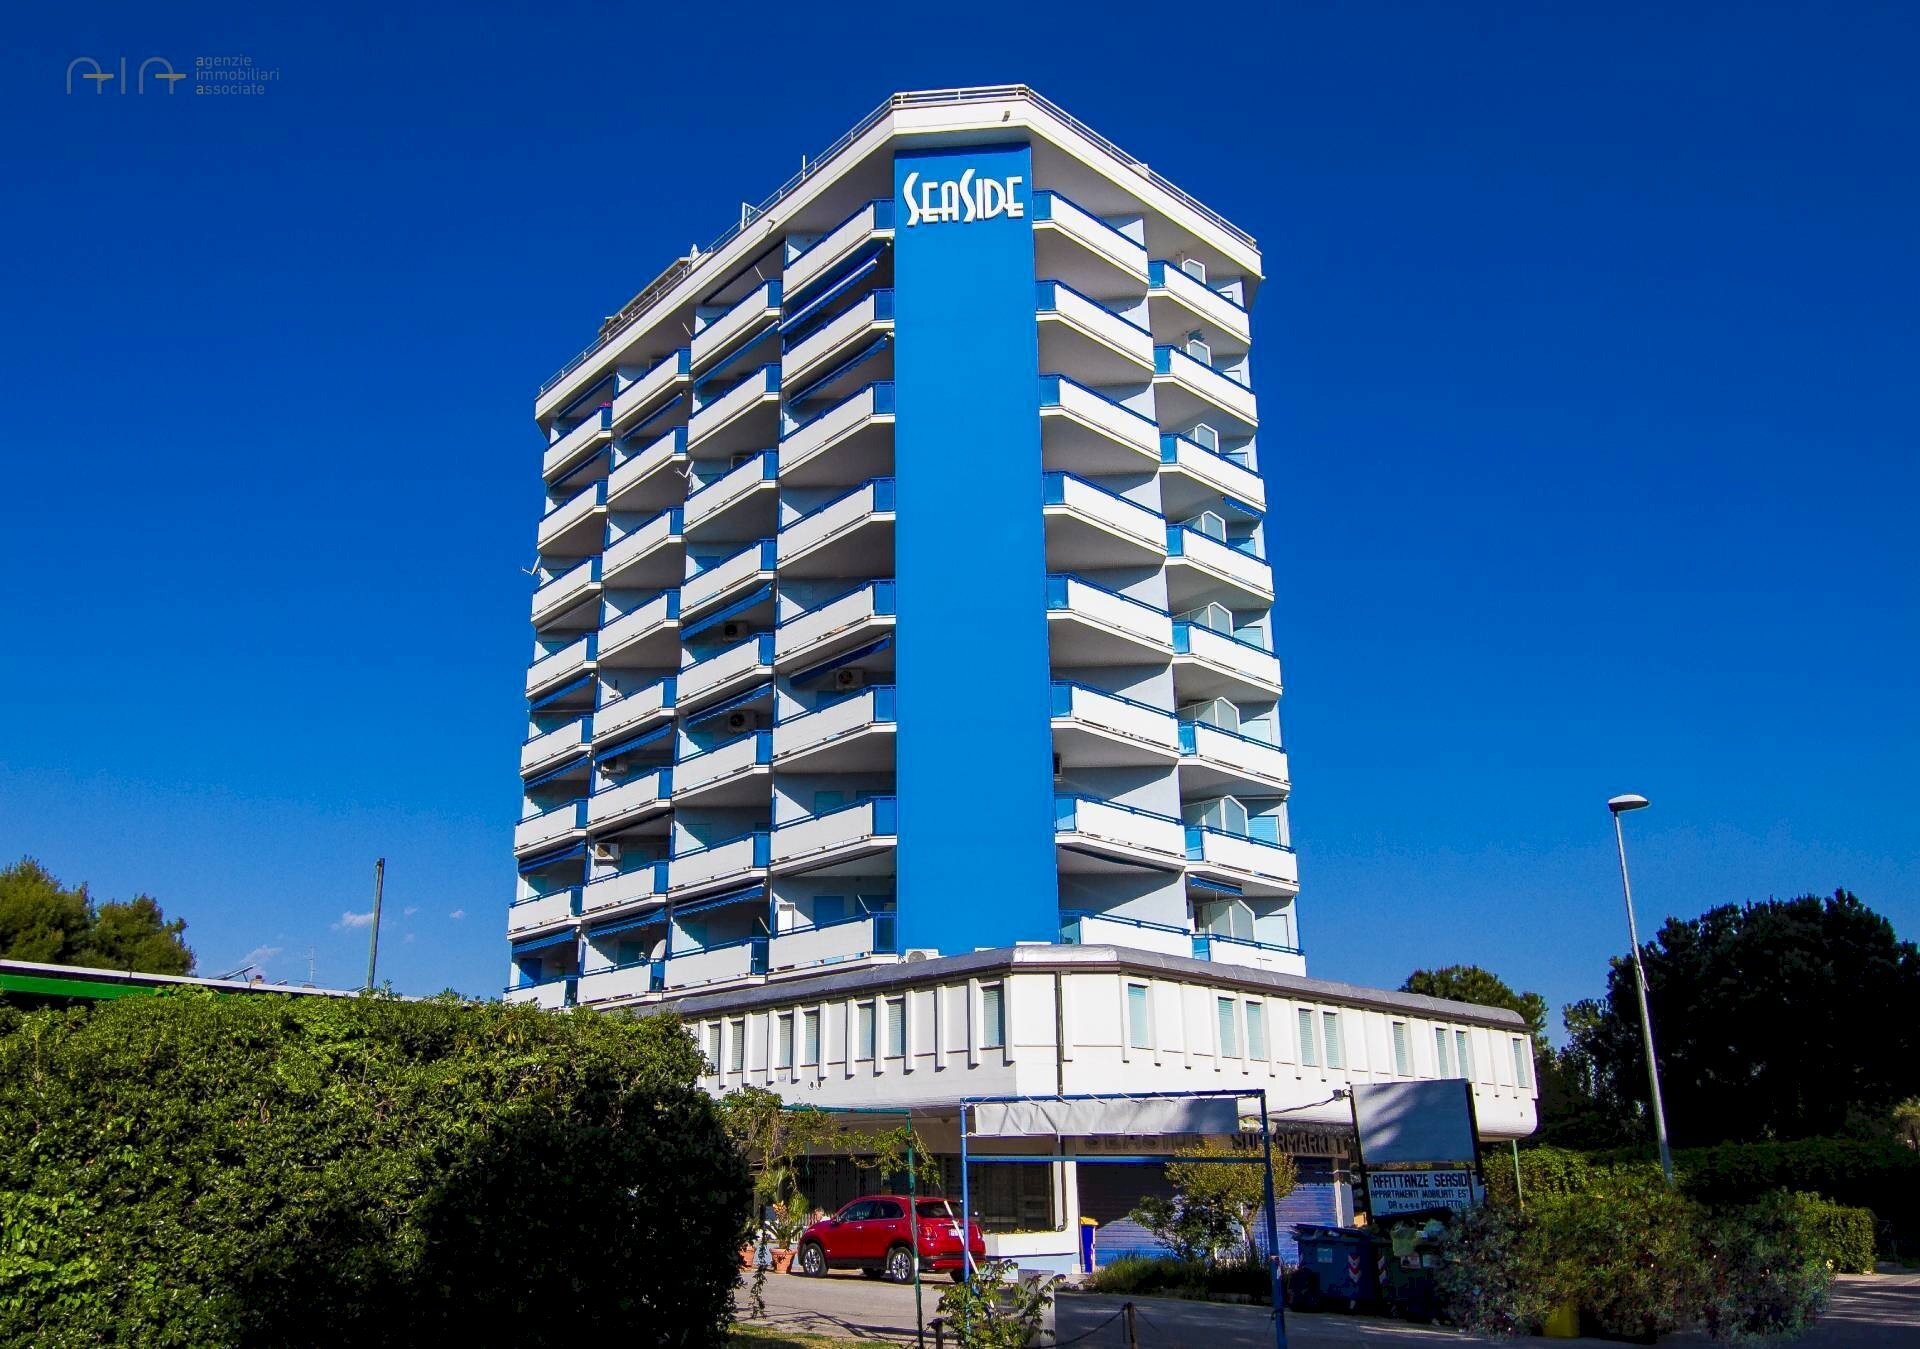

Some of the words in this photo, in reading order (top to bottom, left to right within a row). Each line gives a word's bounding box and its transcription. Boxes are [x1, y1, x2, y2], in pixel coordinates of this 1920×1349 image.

[903, 168, 1024, 227] SEASIDE
[1373, 1173, 1429, 1188] AFFITTANZE
[1434, 1172, 1469, 1187] SEASID
[1371, 1189, 1419, 1198] APPARTAMENTI
